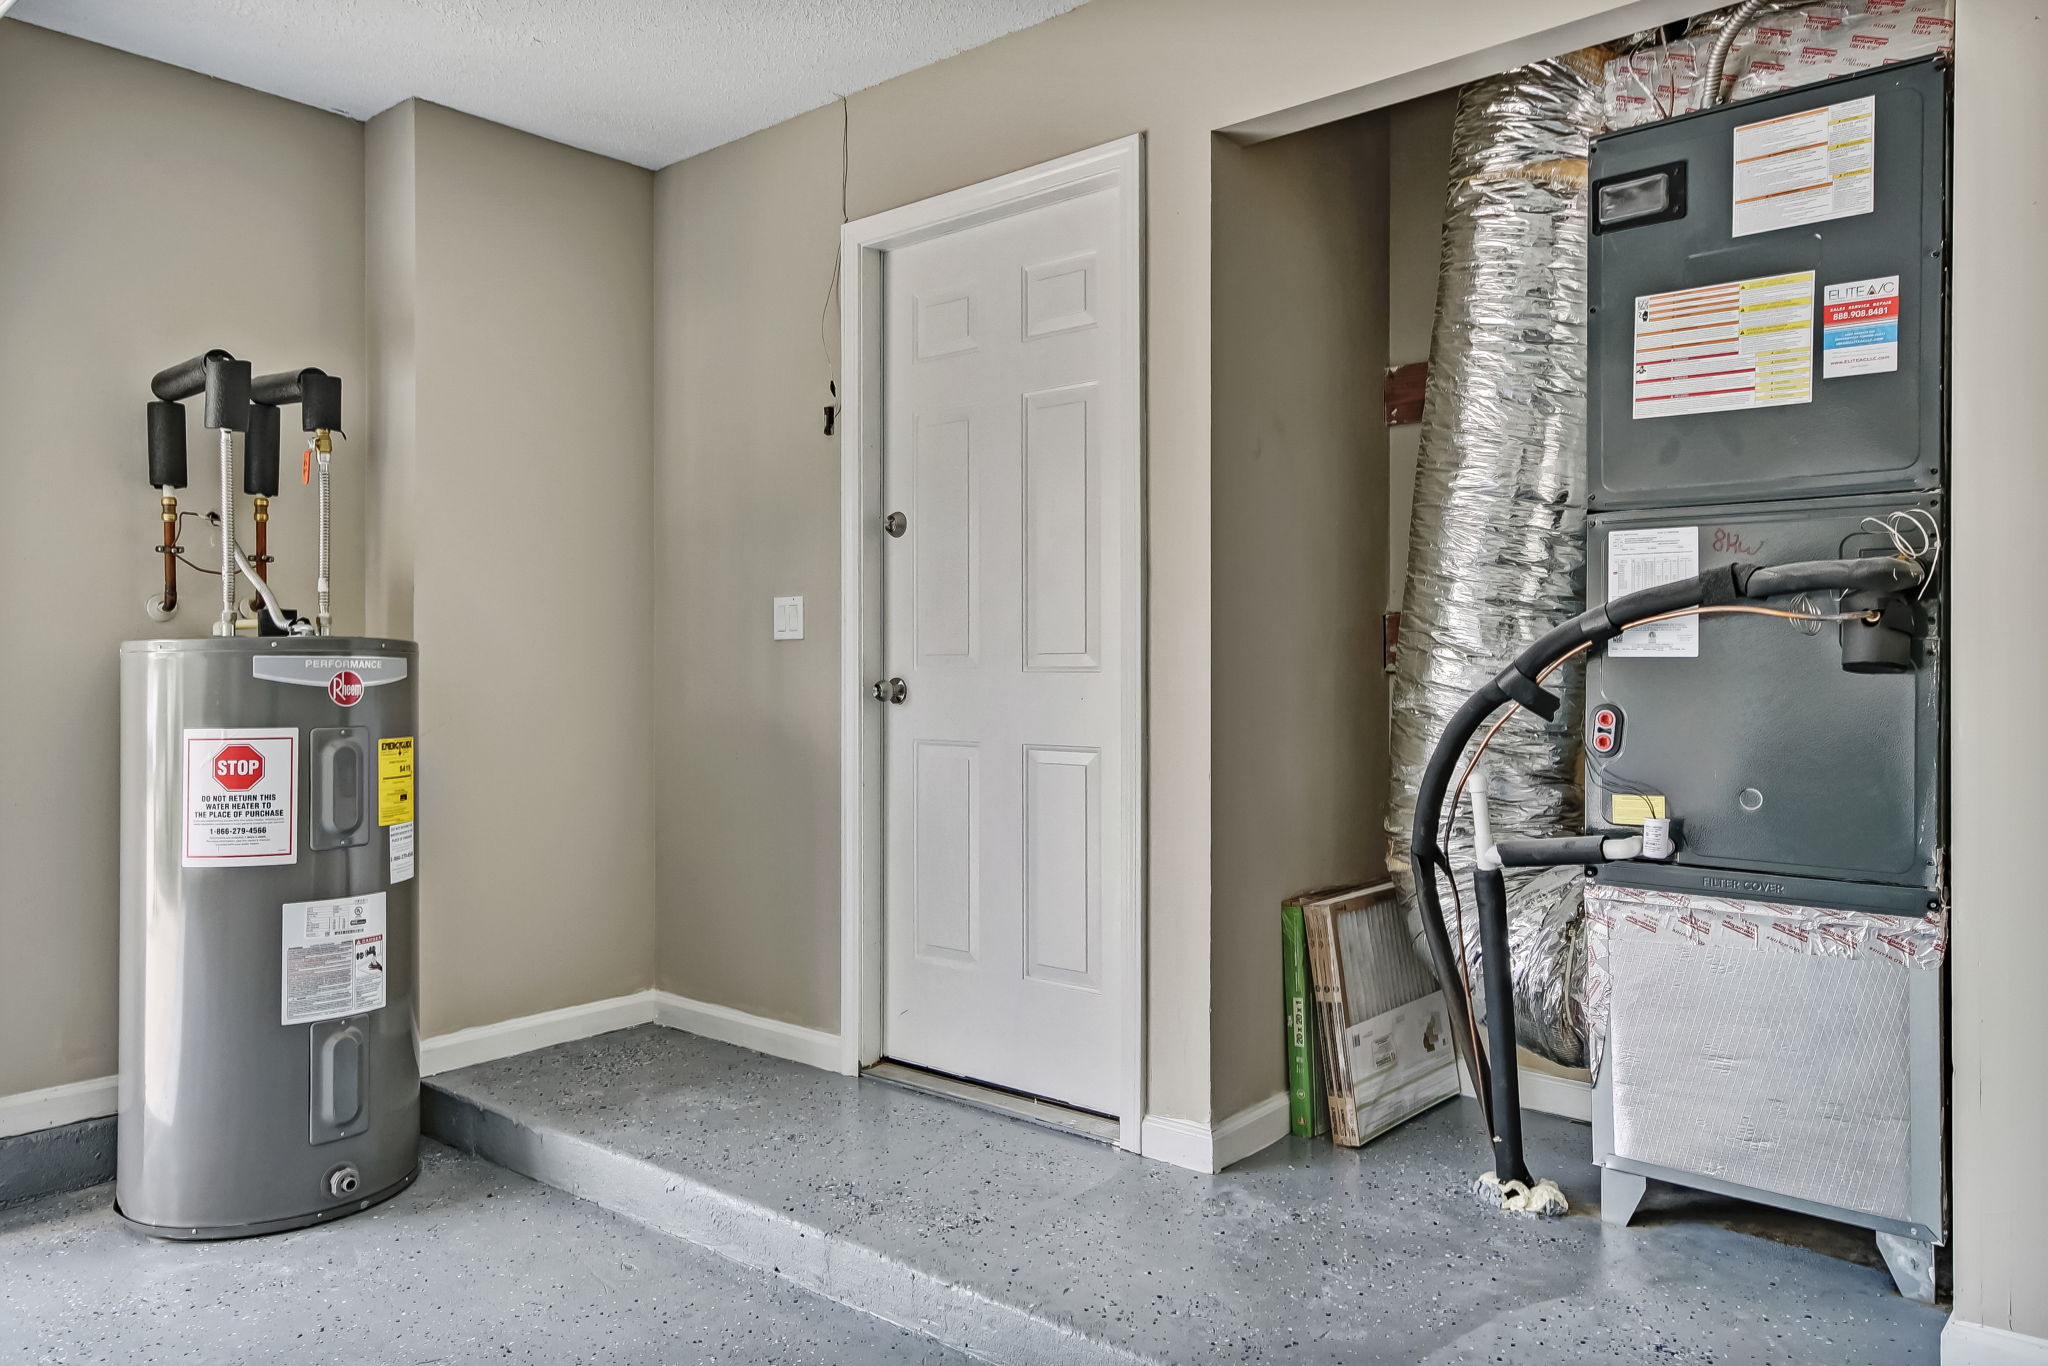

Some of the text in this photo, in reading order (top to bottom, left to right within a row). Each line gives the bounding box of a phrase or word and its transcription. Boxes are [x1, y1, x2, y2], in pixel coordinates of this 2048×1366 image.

[1829, 286, 1865, 300] ELITE
[305, 660, 382, 669] PERFORMANCE
[332, 671, 362, 700] Rheem
[217, 760, 259, 776] STOP
[228, 794, 258, 802] RETURN
[232, 802, 260, 810] HEATER
[245, 809, 284, 817] PURCHASE
[1703, 876, 1784, 894] FILTER COVER
[1296, 1014, 1302, 1025] 20
[1296, 1033, 1303, 1044] 20
